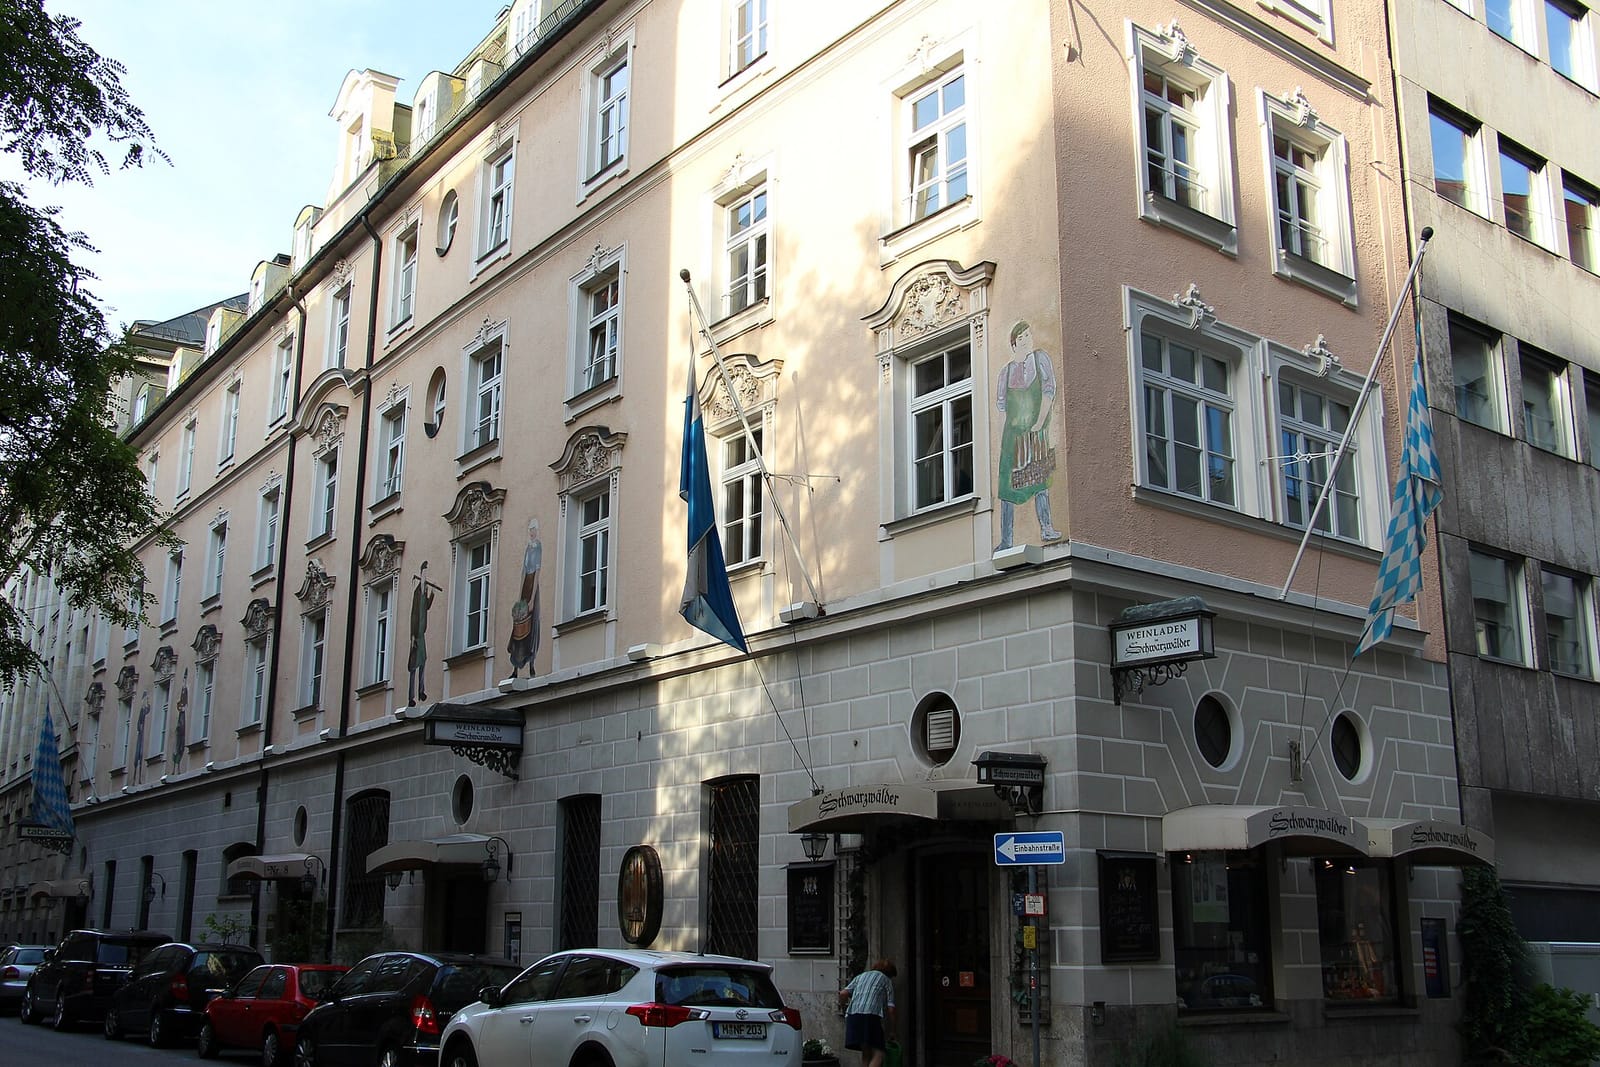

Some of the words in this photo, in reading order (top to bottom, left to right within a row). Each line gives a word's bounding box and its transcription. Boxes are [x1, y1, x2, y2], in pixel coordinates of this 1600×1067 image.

[1127, 624, 1187, 640] WEINLADEN
[1125, 638, 1191, 657] Schwarzwälder
[456, 724, 501, 732] WEINLADEN
[818, 788, 900, 818] Schwarzwälder
[27, 828, 67, 836] tabacco
[1268, 811, 1348, 837] Schwarzwälder
[1410, 826, 1478, 852] Schwarzwälder
[1014, 843, 1061, 853] Einbahnstraße
[746, 1024, 763, 1035] 203
